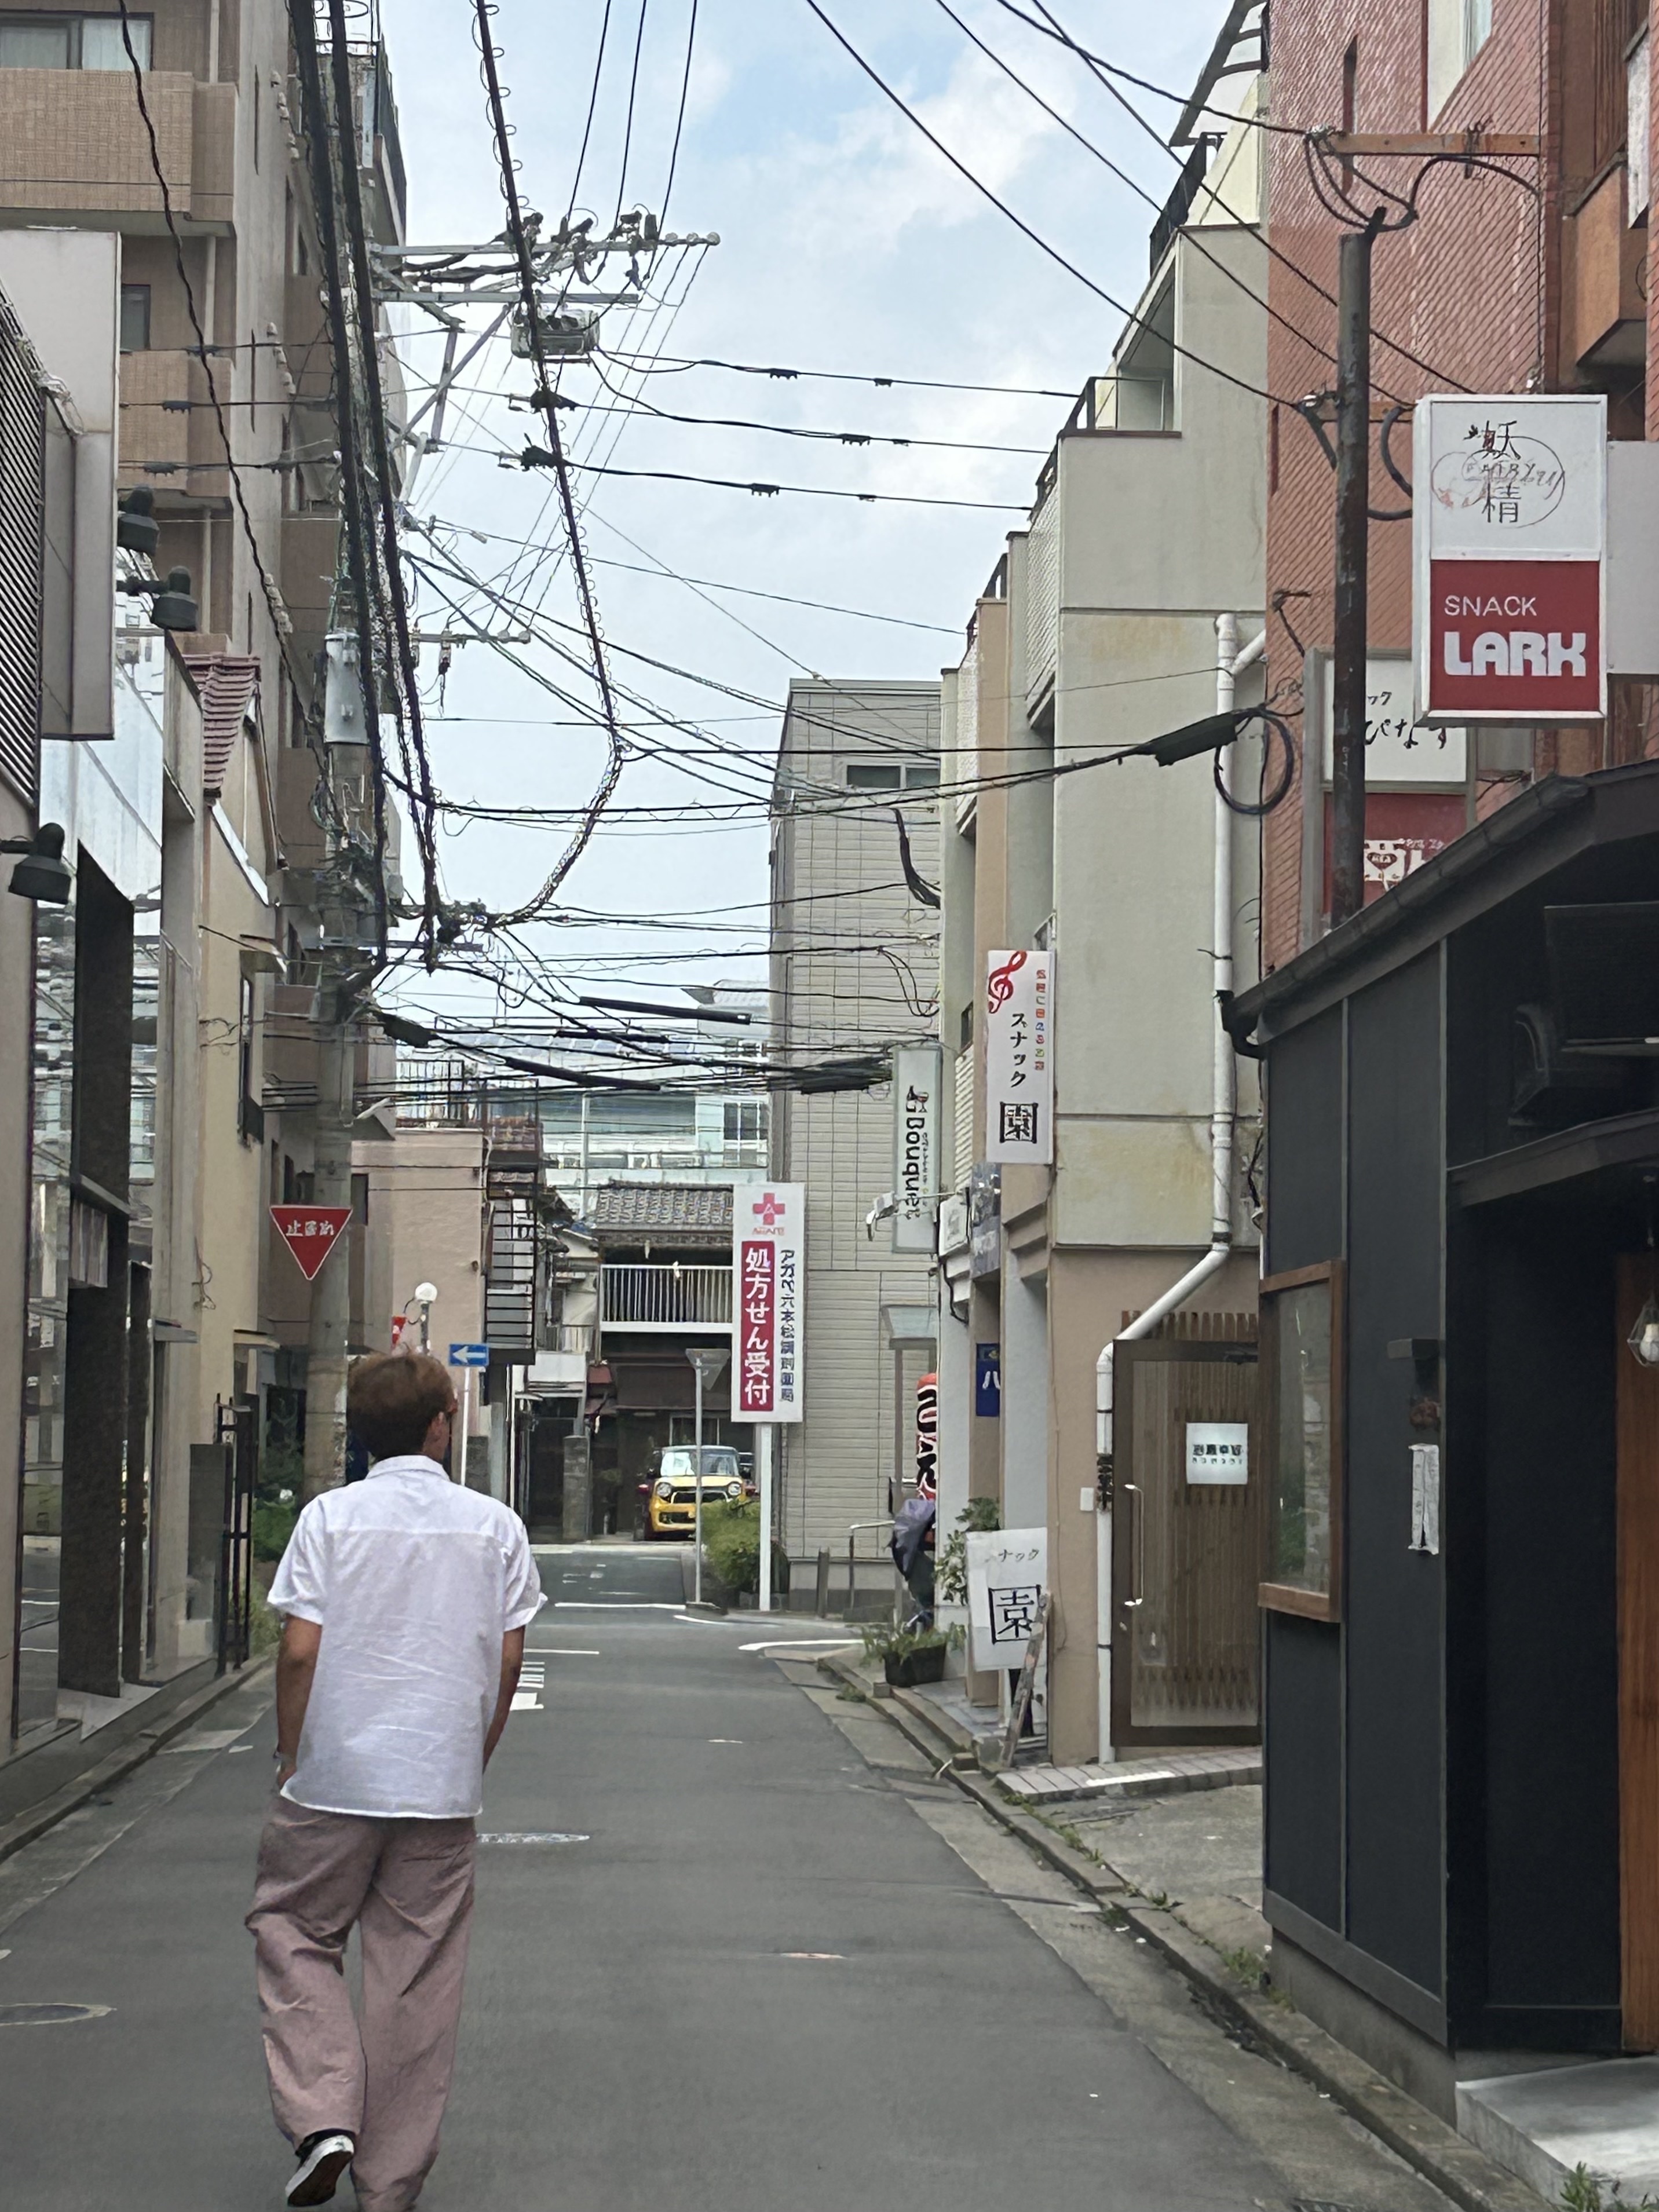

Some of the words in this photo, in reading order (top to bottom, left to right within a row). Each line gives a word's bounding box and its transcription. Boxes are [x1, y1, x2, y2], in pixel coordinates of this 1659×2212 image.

[1444, 595, 1537, 617] SNACK
[1444, 631, 1587, 677] LARK
[1010, 1013, 1028, 1088] スナック
[744, 1248, 771, 1405] 処方せん受付
[988, 1584, 1042, 1645] 園
